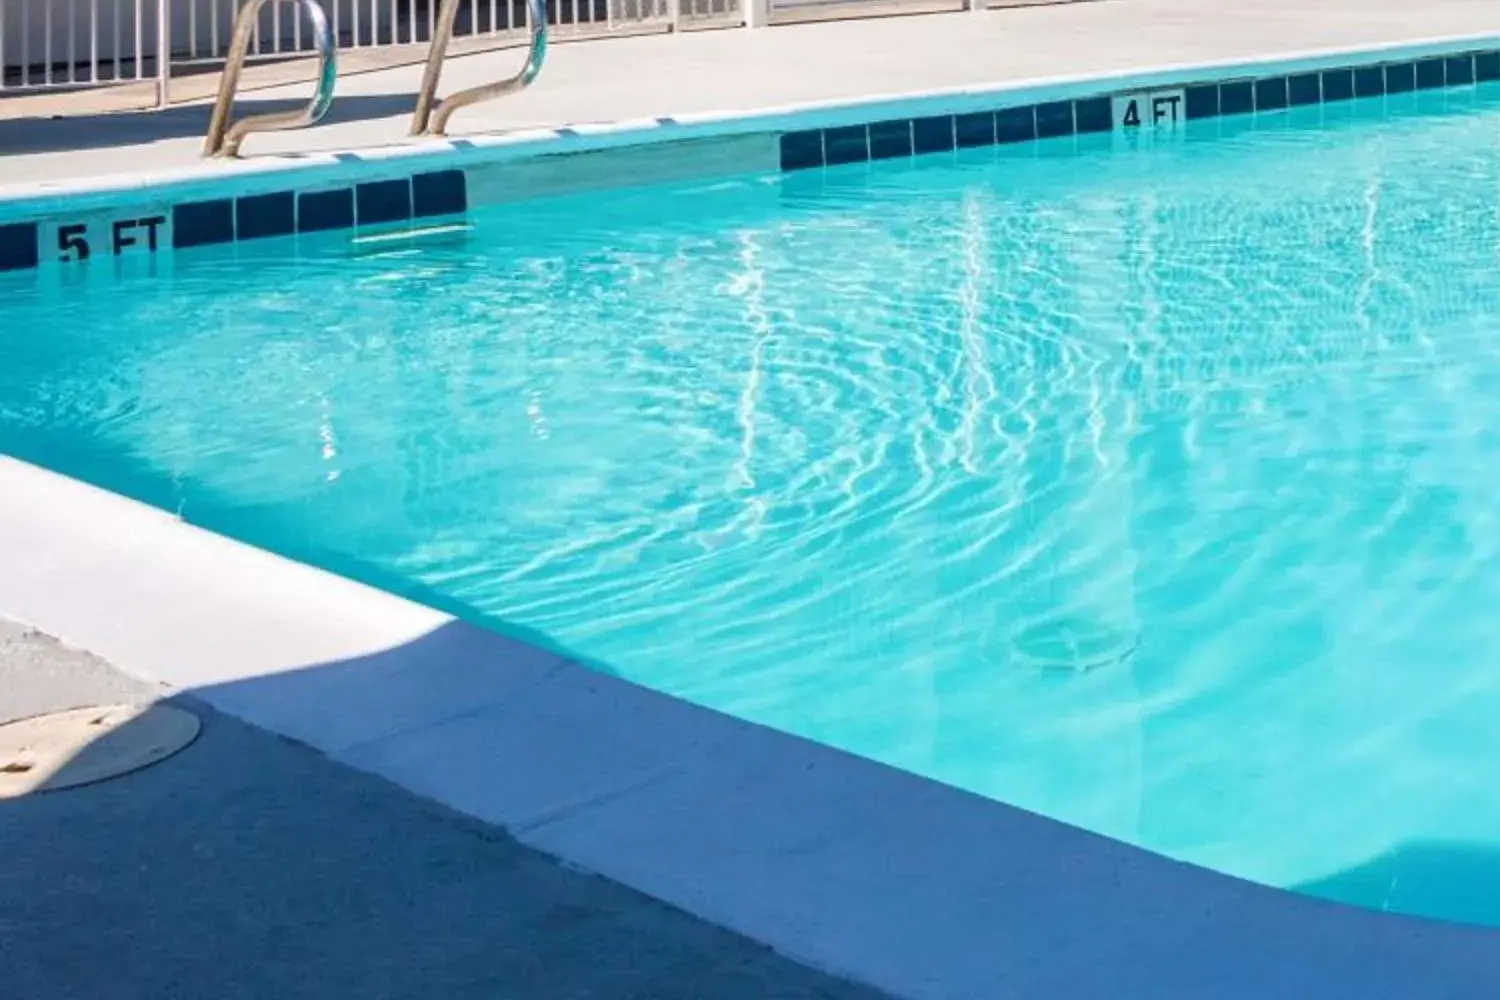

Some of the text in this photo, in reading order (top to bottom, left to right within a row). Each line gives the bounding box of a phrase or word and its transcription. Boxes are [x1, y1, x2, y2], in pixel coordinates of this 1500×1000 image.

[1123, 95, 1181, 126] 4 FT
[58, 215, 166, 261] 5 FT
